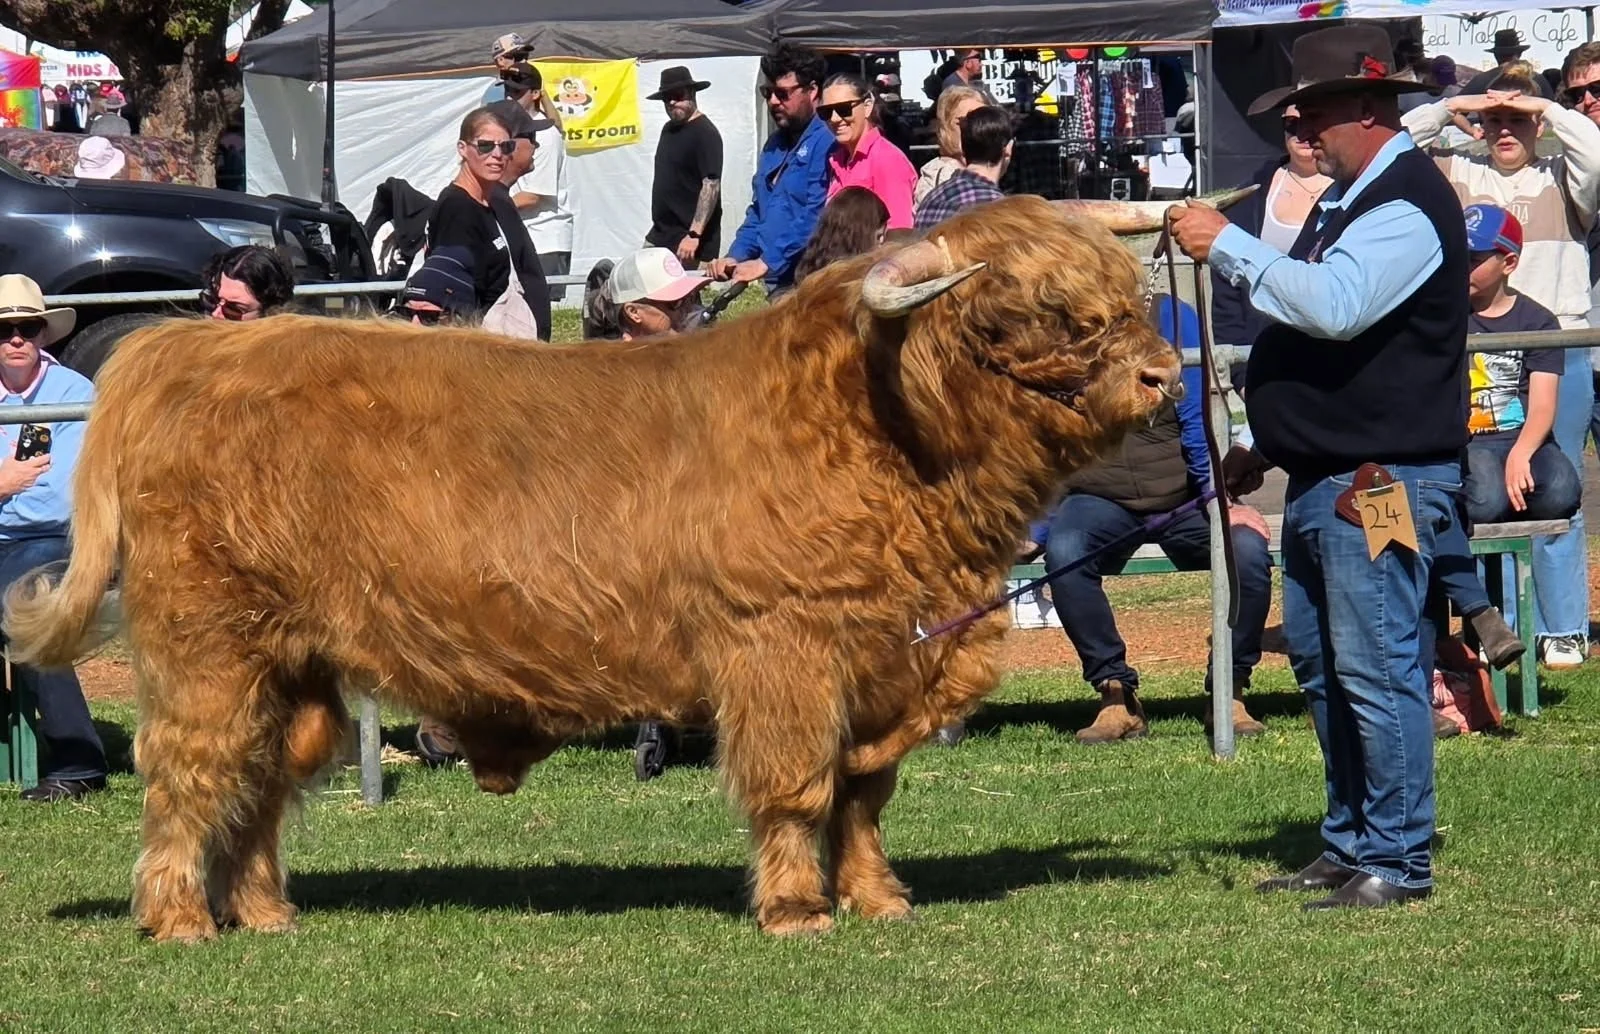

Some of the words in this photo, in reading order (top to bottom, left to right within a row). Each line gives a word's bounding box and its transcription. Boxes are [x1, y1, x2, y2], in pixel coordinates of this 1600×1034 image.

[1458, 15, 1526, 45] Moble
[1532, 14, 1578, 51] Cafe
[66, 63, 102, 77] KIDS
[588, 125, 636, 139] room
[1364, 502, 1402, 529] 24
